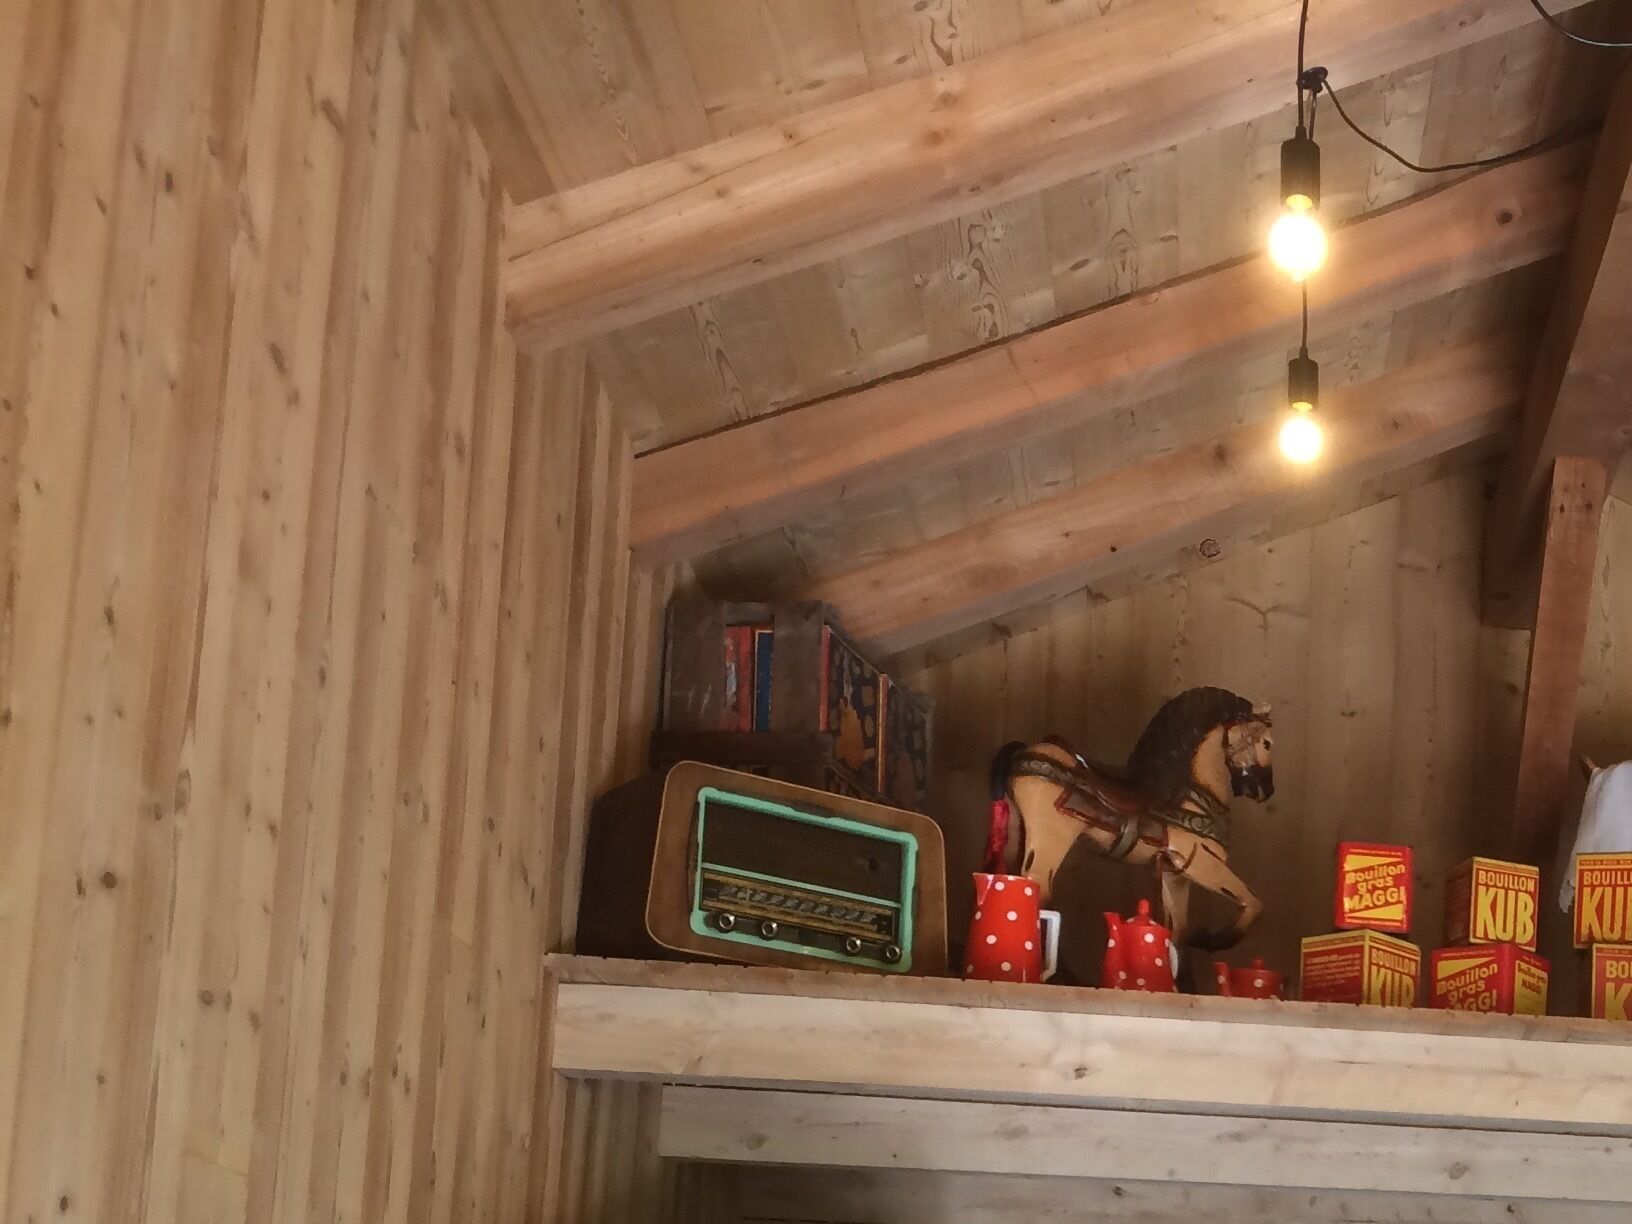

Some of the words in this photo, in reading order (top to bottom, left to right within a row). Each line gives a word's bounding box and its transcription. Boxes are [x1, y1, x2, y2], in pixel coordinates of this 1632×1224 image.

[1345, 864, 1406, 884] Bouillon
[1356, 876, 1394, 895] gras
[1478, 869, 1535, 892] BOUILLON
[1344, 886, 1406, 912] MAGGI
[1475, 885, 1535, 945] KUB
[1371, 947, 1416, 977] BOUILLON
[1436, 963, 1498, 995] Bouillon
[1447, 979, 1486, 1005] gras
[1446, 988, 1497, 1012] GGI
